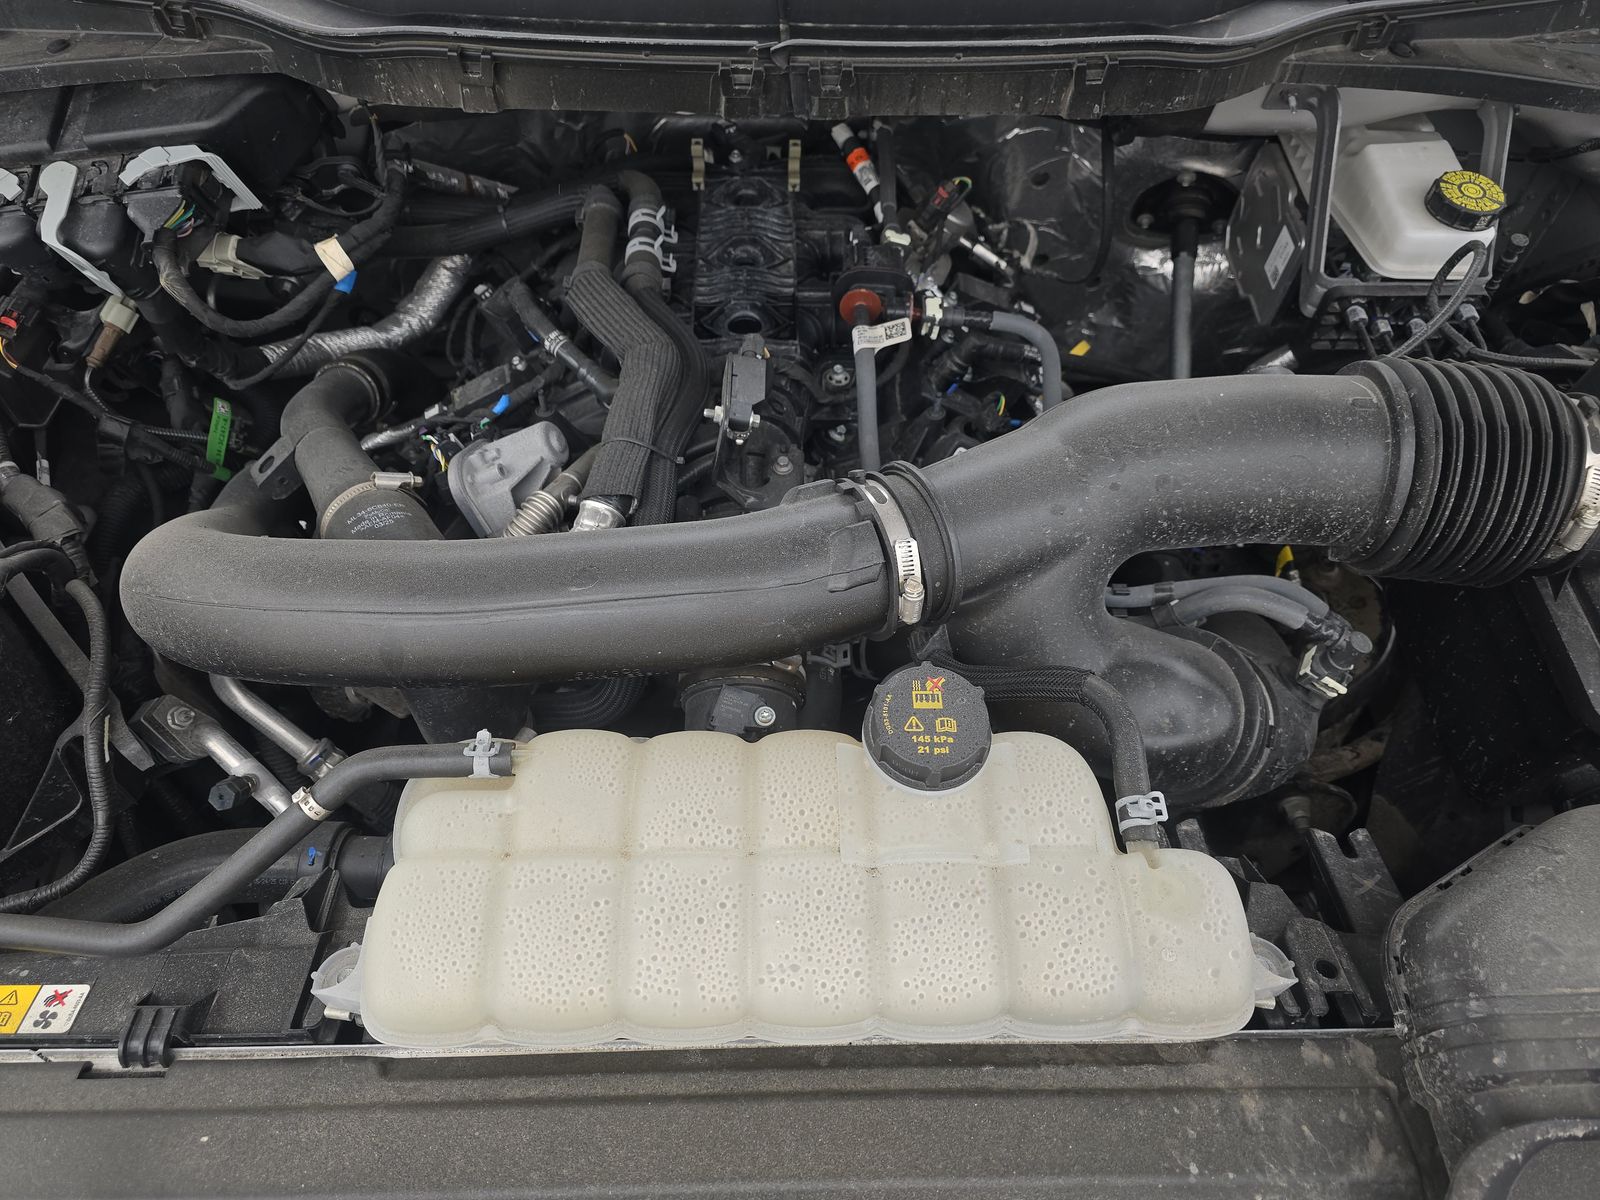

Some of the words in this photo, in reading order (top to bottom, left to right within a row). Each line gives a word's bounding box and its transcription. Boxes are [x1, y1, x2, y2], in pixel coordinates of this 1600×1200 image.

[911, 735, 931, 743] 145
[933, 735, 954, 743] kPa
[917, 746, 930, 754] 21
[933, 746, 950, 755] psi
